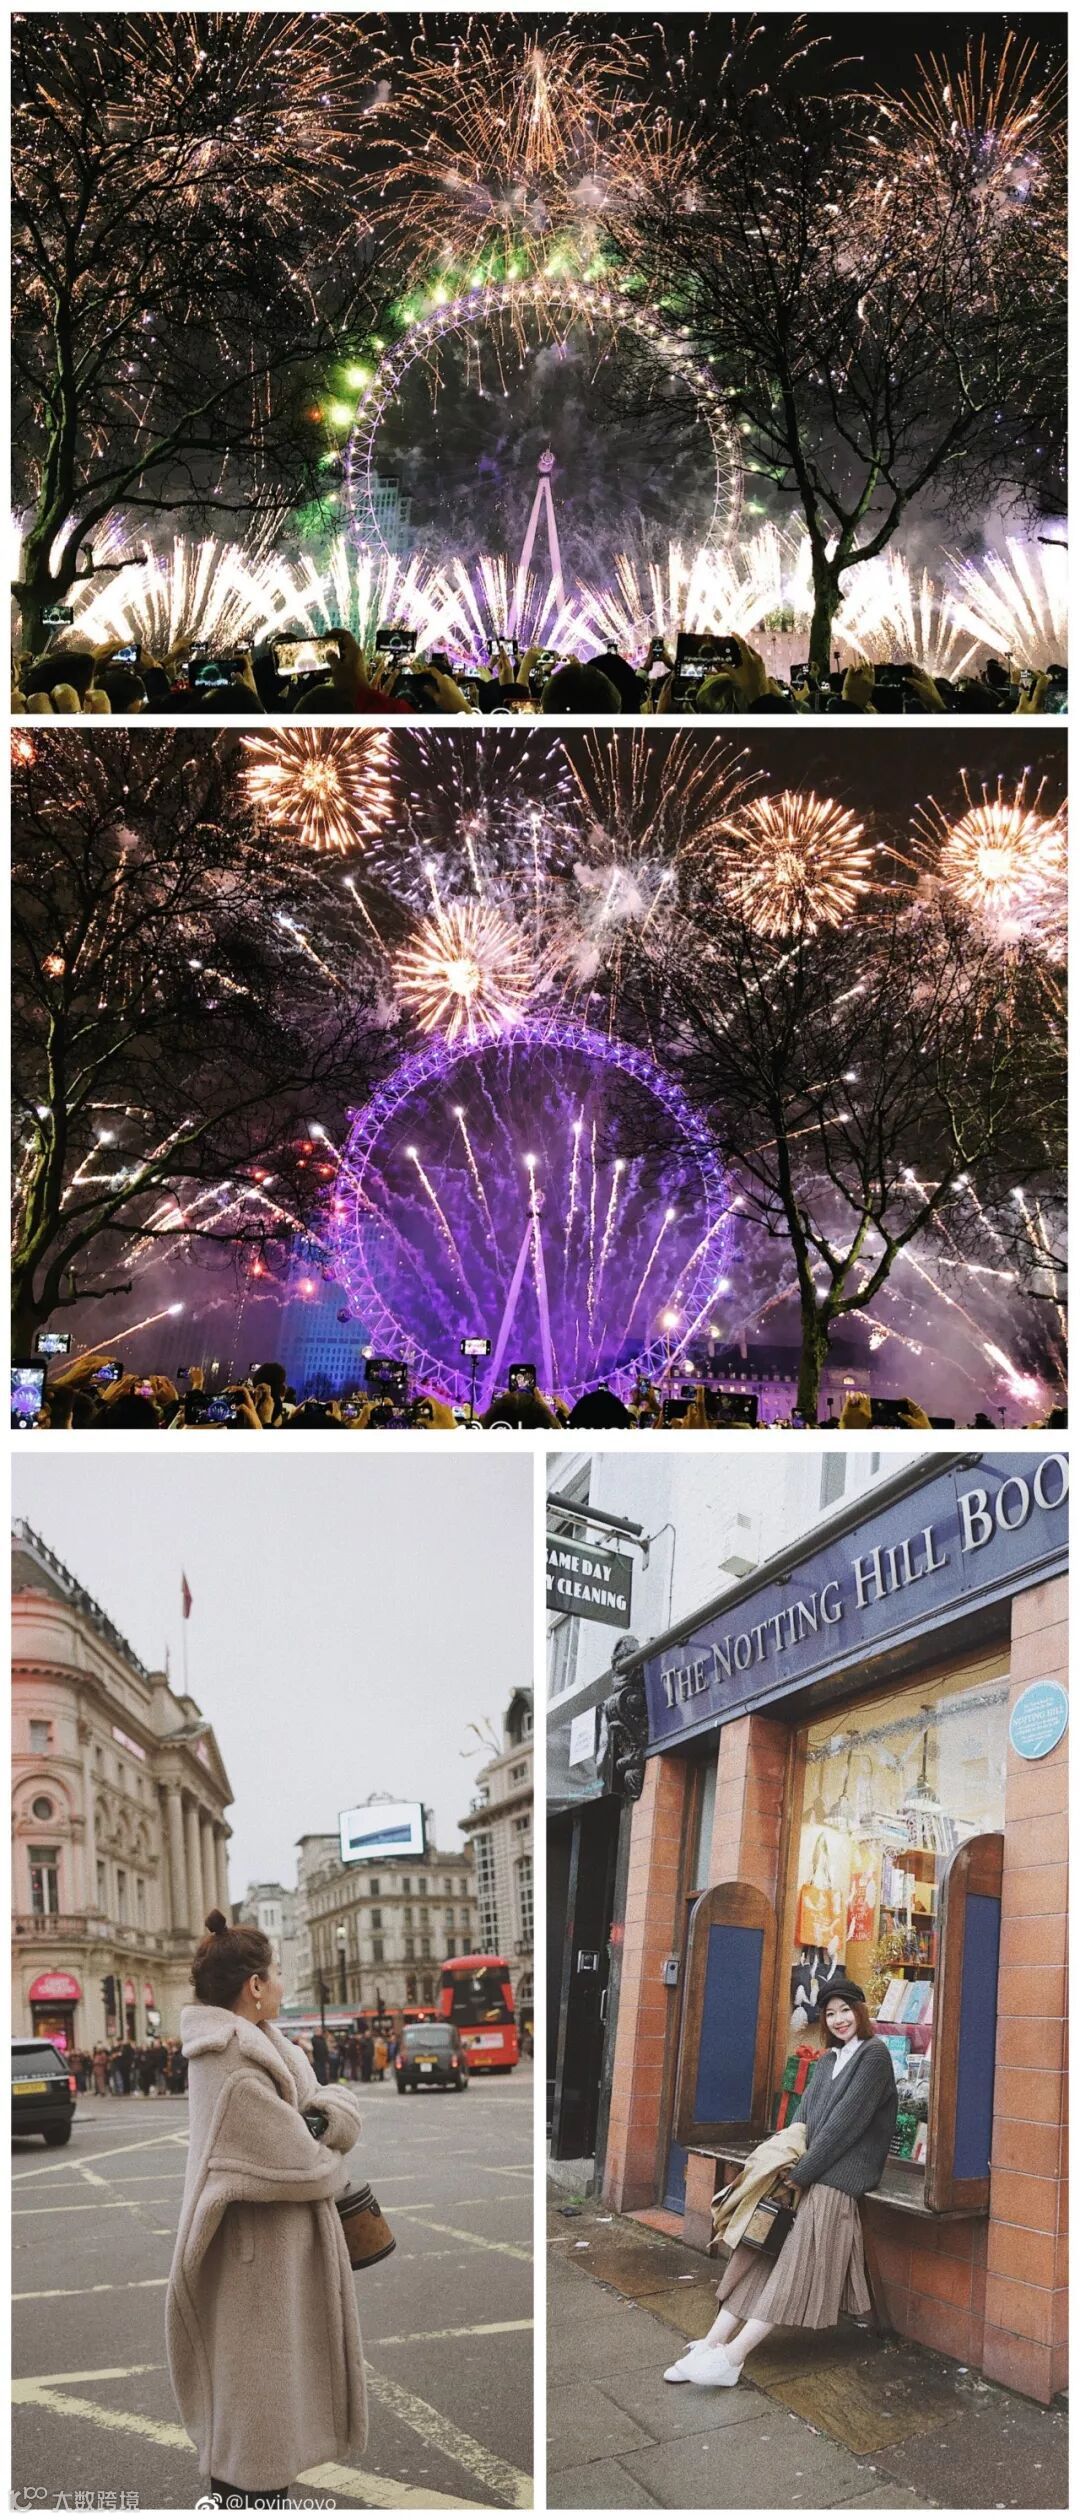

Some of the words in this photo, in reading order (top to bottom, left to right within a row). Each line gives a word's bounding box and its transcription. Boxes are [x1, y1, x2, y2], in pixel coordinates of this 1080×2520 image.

[582, 1559, 612, 1582] DAY
[660, 1659, 706, 1709] THE
[710, 1580, 842, 1684] NOTTING
[850, 1525, 947, 1610] HILL
[957, 1453, 1069, 1553] BOO
[557, 1577, 627, 1611] CLEANING
